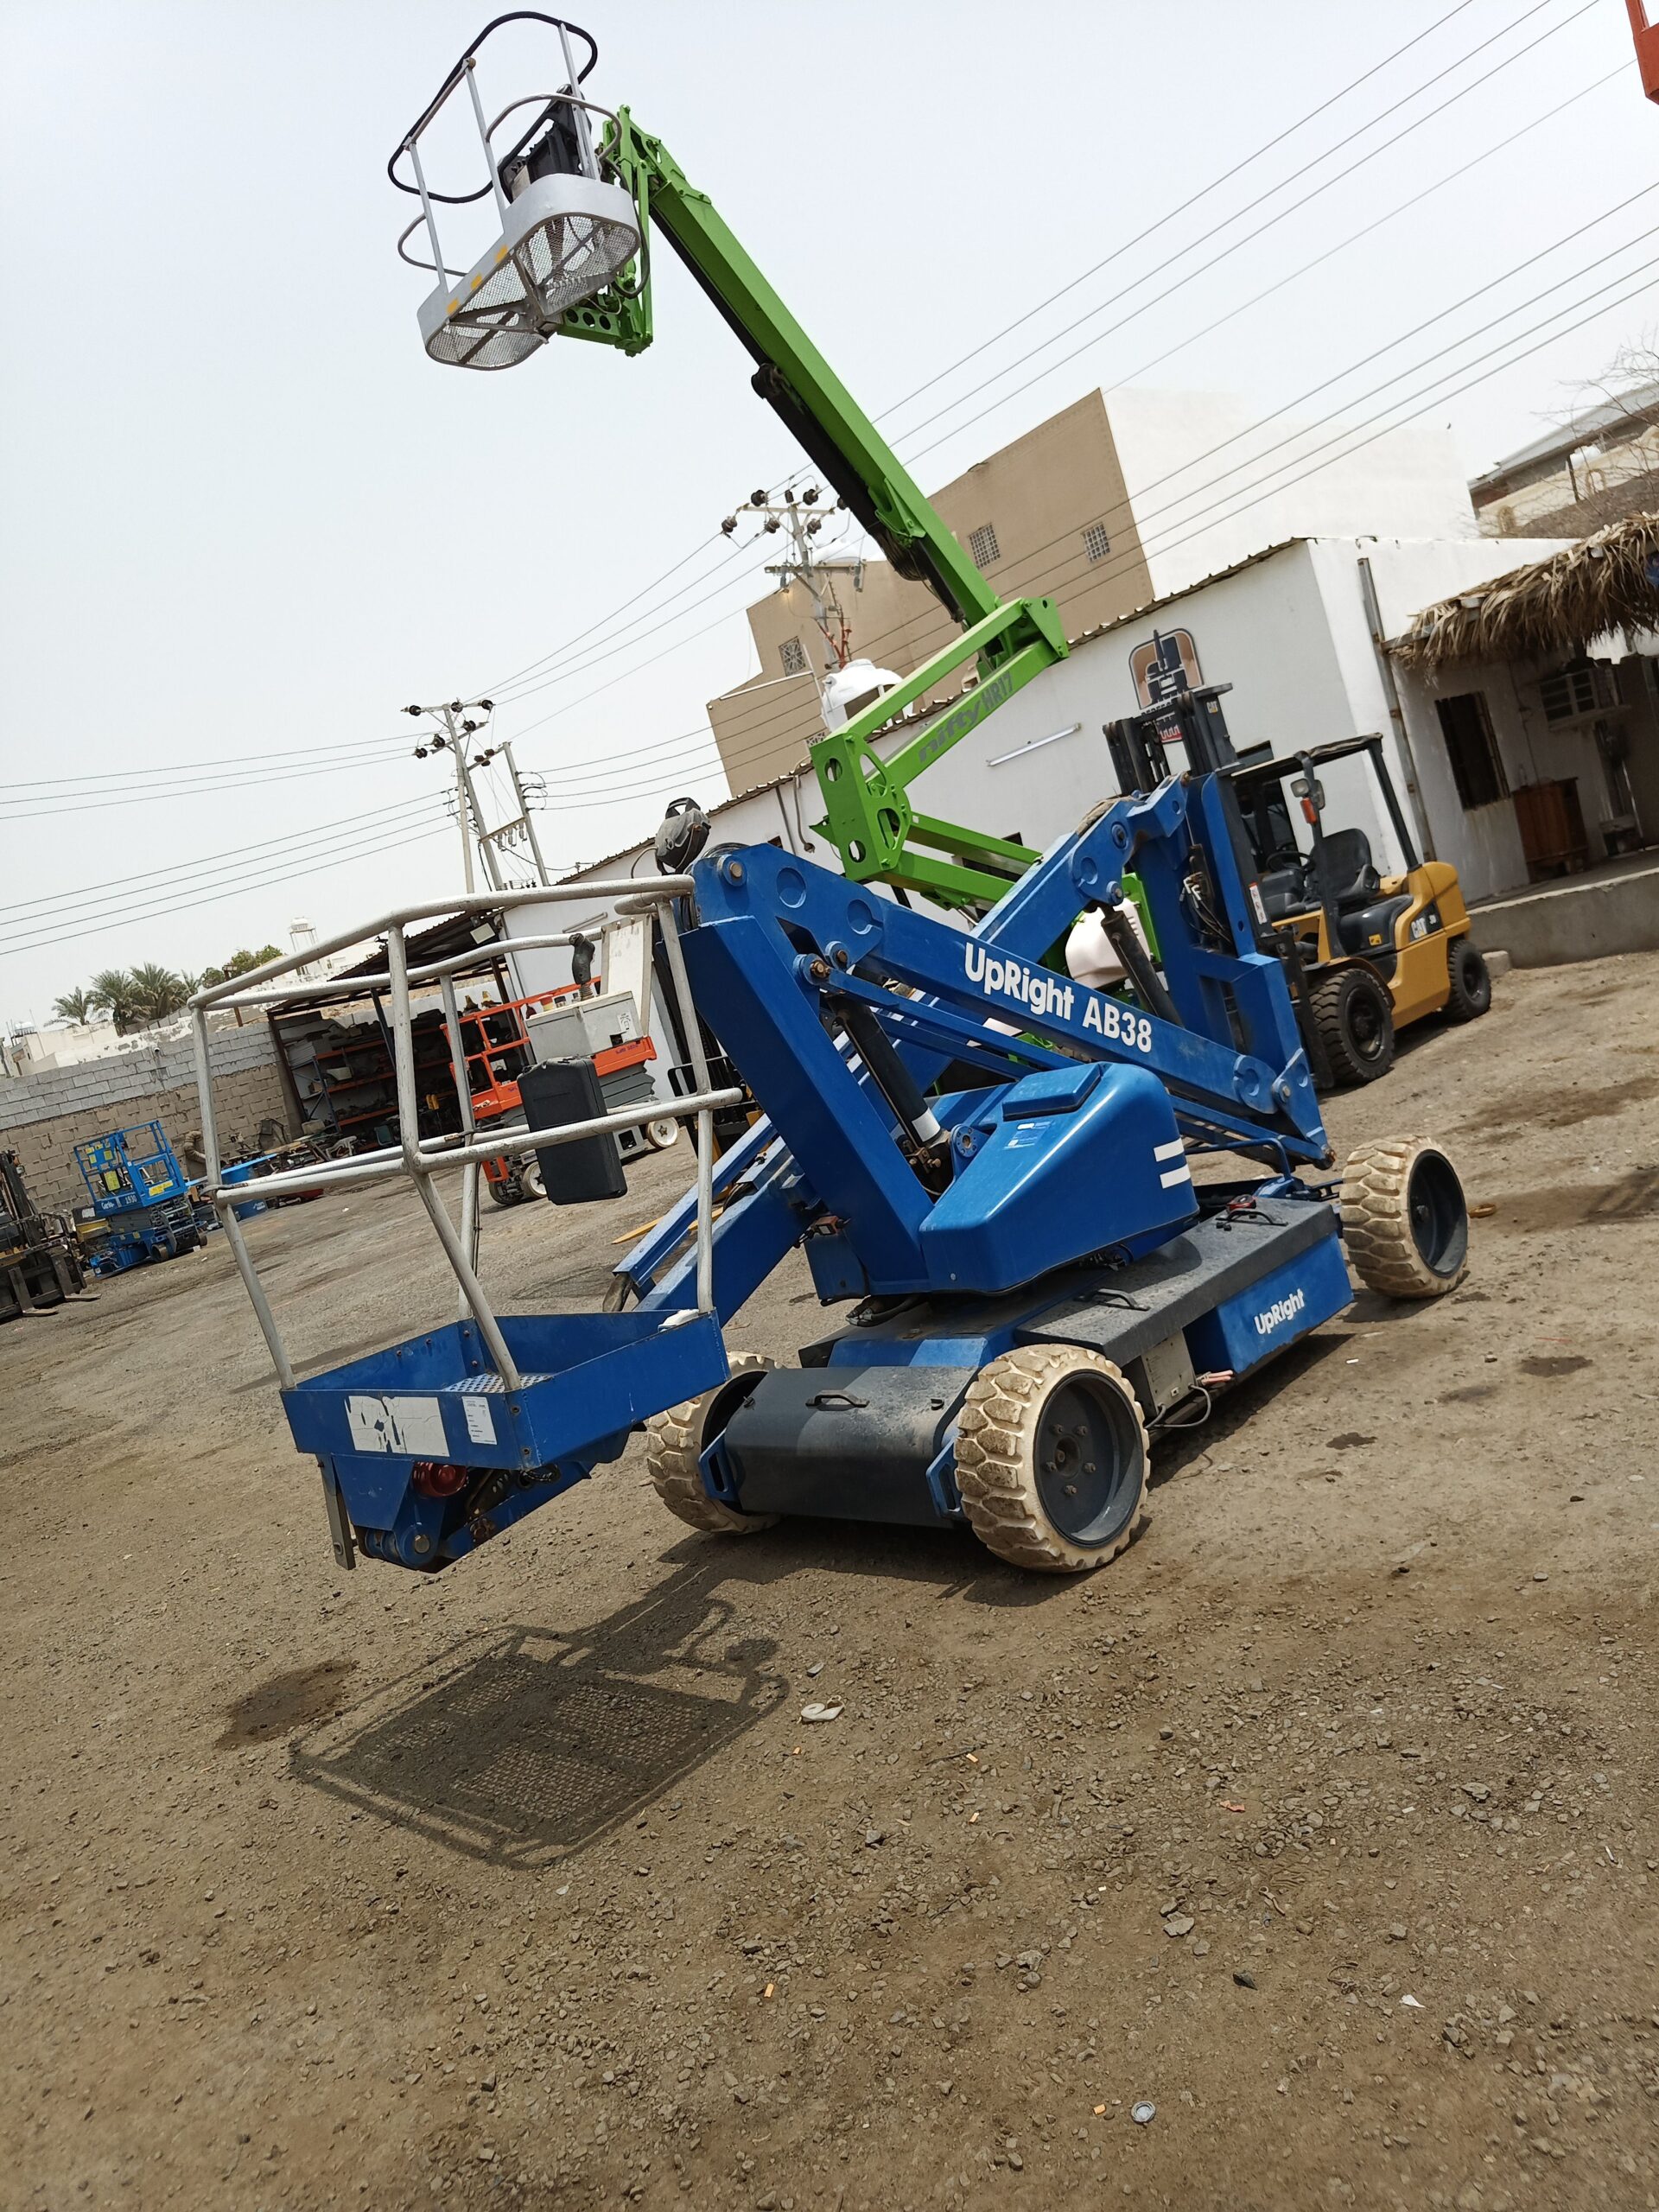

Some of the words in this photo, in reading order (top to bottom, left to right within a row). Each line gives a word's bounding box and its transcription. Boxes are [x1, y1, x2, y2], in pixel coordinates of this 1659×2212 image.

[1206, 701, 1218, 714] CAT
[918, 700, 980, 762] nifty
[1411, 918, 1427, 938] CAT
[964, 942, 1074, 1020] UpRight
[1082, 996, 1152, 1053] AB38
[1254, 1288, 1305, 1334] UpRight
